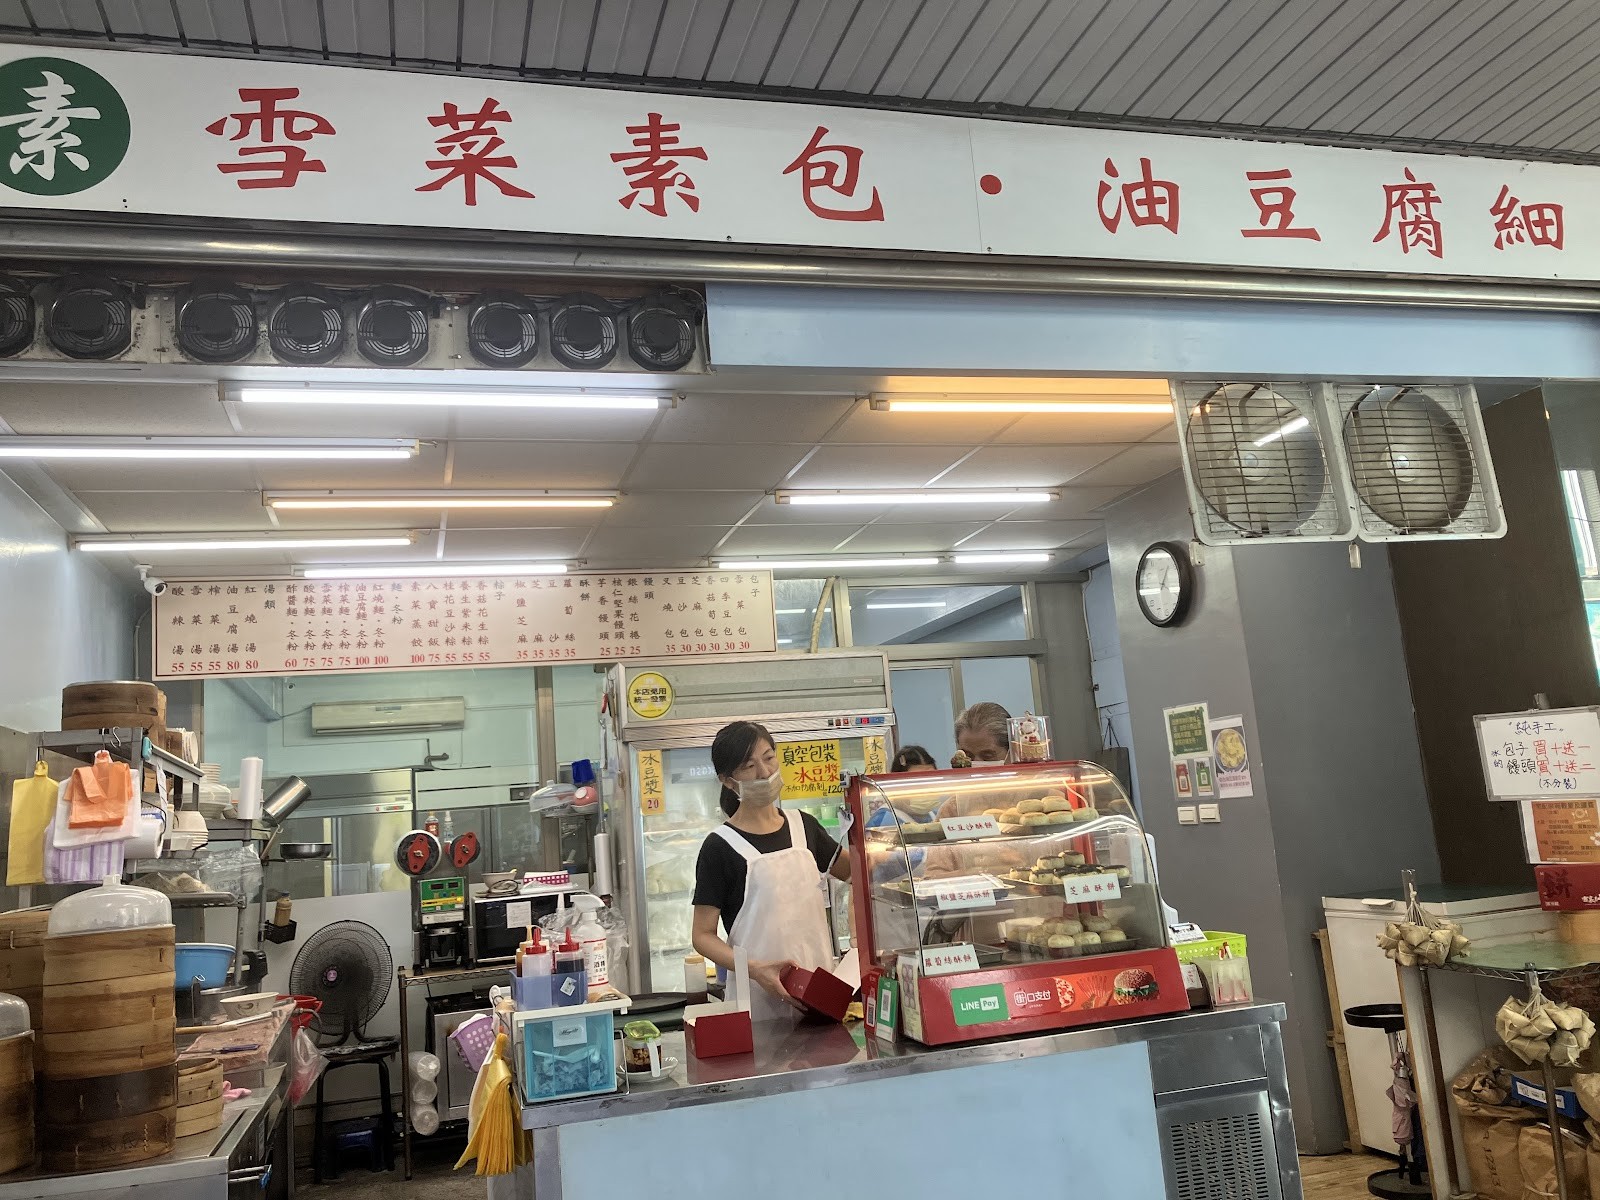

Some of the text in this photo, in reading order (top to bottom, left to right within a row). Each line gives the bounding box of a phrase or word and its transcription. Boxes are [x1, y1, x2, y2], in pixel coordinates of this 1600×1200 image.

[0, 70, 100, 181] 素
[579, 578, 591, 602] 酥餅
[643, 577, 655, 600] 饅頭
[750, 574, 760, 598] 包子
[263, 584, 276, 609] 湯類
[661, 577, 674, 638] 叉燒包
[677, 576, 689, 637] 豆沙包
[691, 576, 704, 637] 芝麻包
[720, 576, 733, 636] 四季豆包
[734, 575, 747, 635] 雪菜包
[531, 579, 544, 643] 芝麻
[547, 579, 560, 643] 豆沙
[171, 586, 185, 655] 酸辣湯
[190, 586, 203, 654] 雪菜湯
[226, 585, 239, 653] 油豆腐湯
[244, 586, 258, 653] 紅燒湯
[630, 645, 641, 655] 25
[665, 644, 676, 653] 35
[680, 643, 692, 653] 30
[695, 643, 707, 652] 30
[709, 642, 720, 652] 30
[724, 641, 736, 651] 30
[739, 641, 750, 650] 30
[517, 650, 529, 660] 35
[532, 649, 545, 659] 35
[548, 649, 560, 658] 35
[564, 648, 576, 658] 35
[600, 647, 611, 657] 25
[615, 646, 626, 656] 25
[339, 656, 351, 666] 75
[355, 656, 370, 665] 100
[374, 655, 389, 665] 100
[410, 654, 425, 664] 100
[428, 653, 440, 663] 75
[445, 653, 457, 663] 55
[462, 652, 474, 662] 55
[479, 652, 491, 661] 55
[171, 662, 185, 672] 55
[190, 661, 203, 671] 55
[208, 661, 221, 671] 55
[227, 661, 240, 670] 80
[245, 660, 259, 669] 80
[284, 659, 298, 668] 60
[302, 658, 316, 667] 75
[321, 657, 333, 667] 75
[782, 743, 838, 767] 真空包裝
[641, 754, 662, 795] 冰豆漿
[793, 763, 841, 784] 冰豆漿
[647, 799, 660, 809] 20
[947, 821, 993, 833] 紅豆沙酥餅
[1069, 882, 1116, 897] 芝麻酥餅
[960, 1000, 999, 1011] LINE Pay
